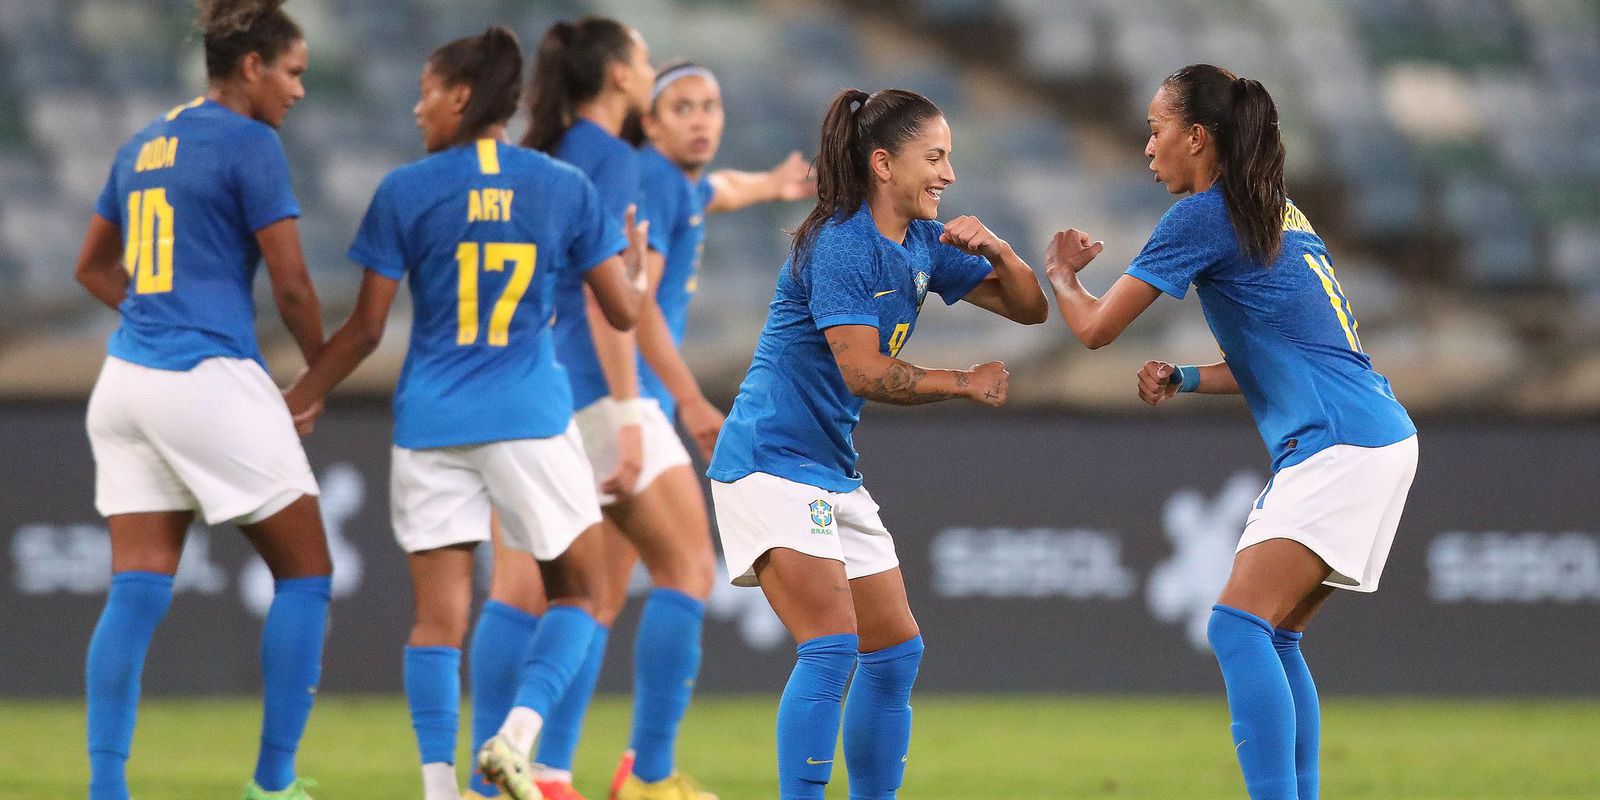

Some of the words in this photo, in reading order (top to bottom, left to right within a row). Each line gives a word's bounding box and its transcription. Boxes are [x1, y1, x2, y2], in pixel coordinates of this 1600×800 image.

[124, 187, 174, 294] 10
[467, 188, 514, 223] ARY
[455, 242, 537, 347] 17
